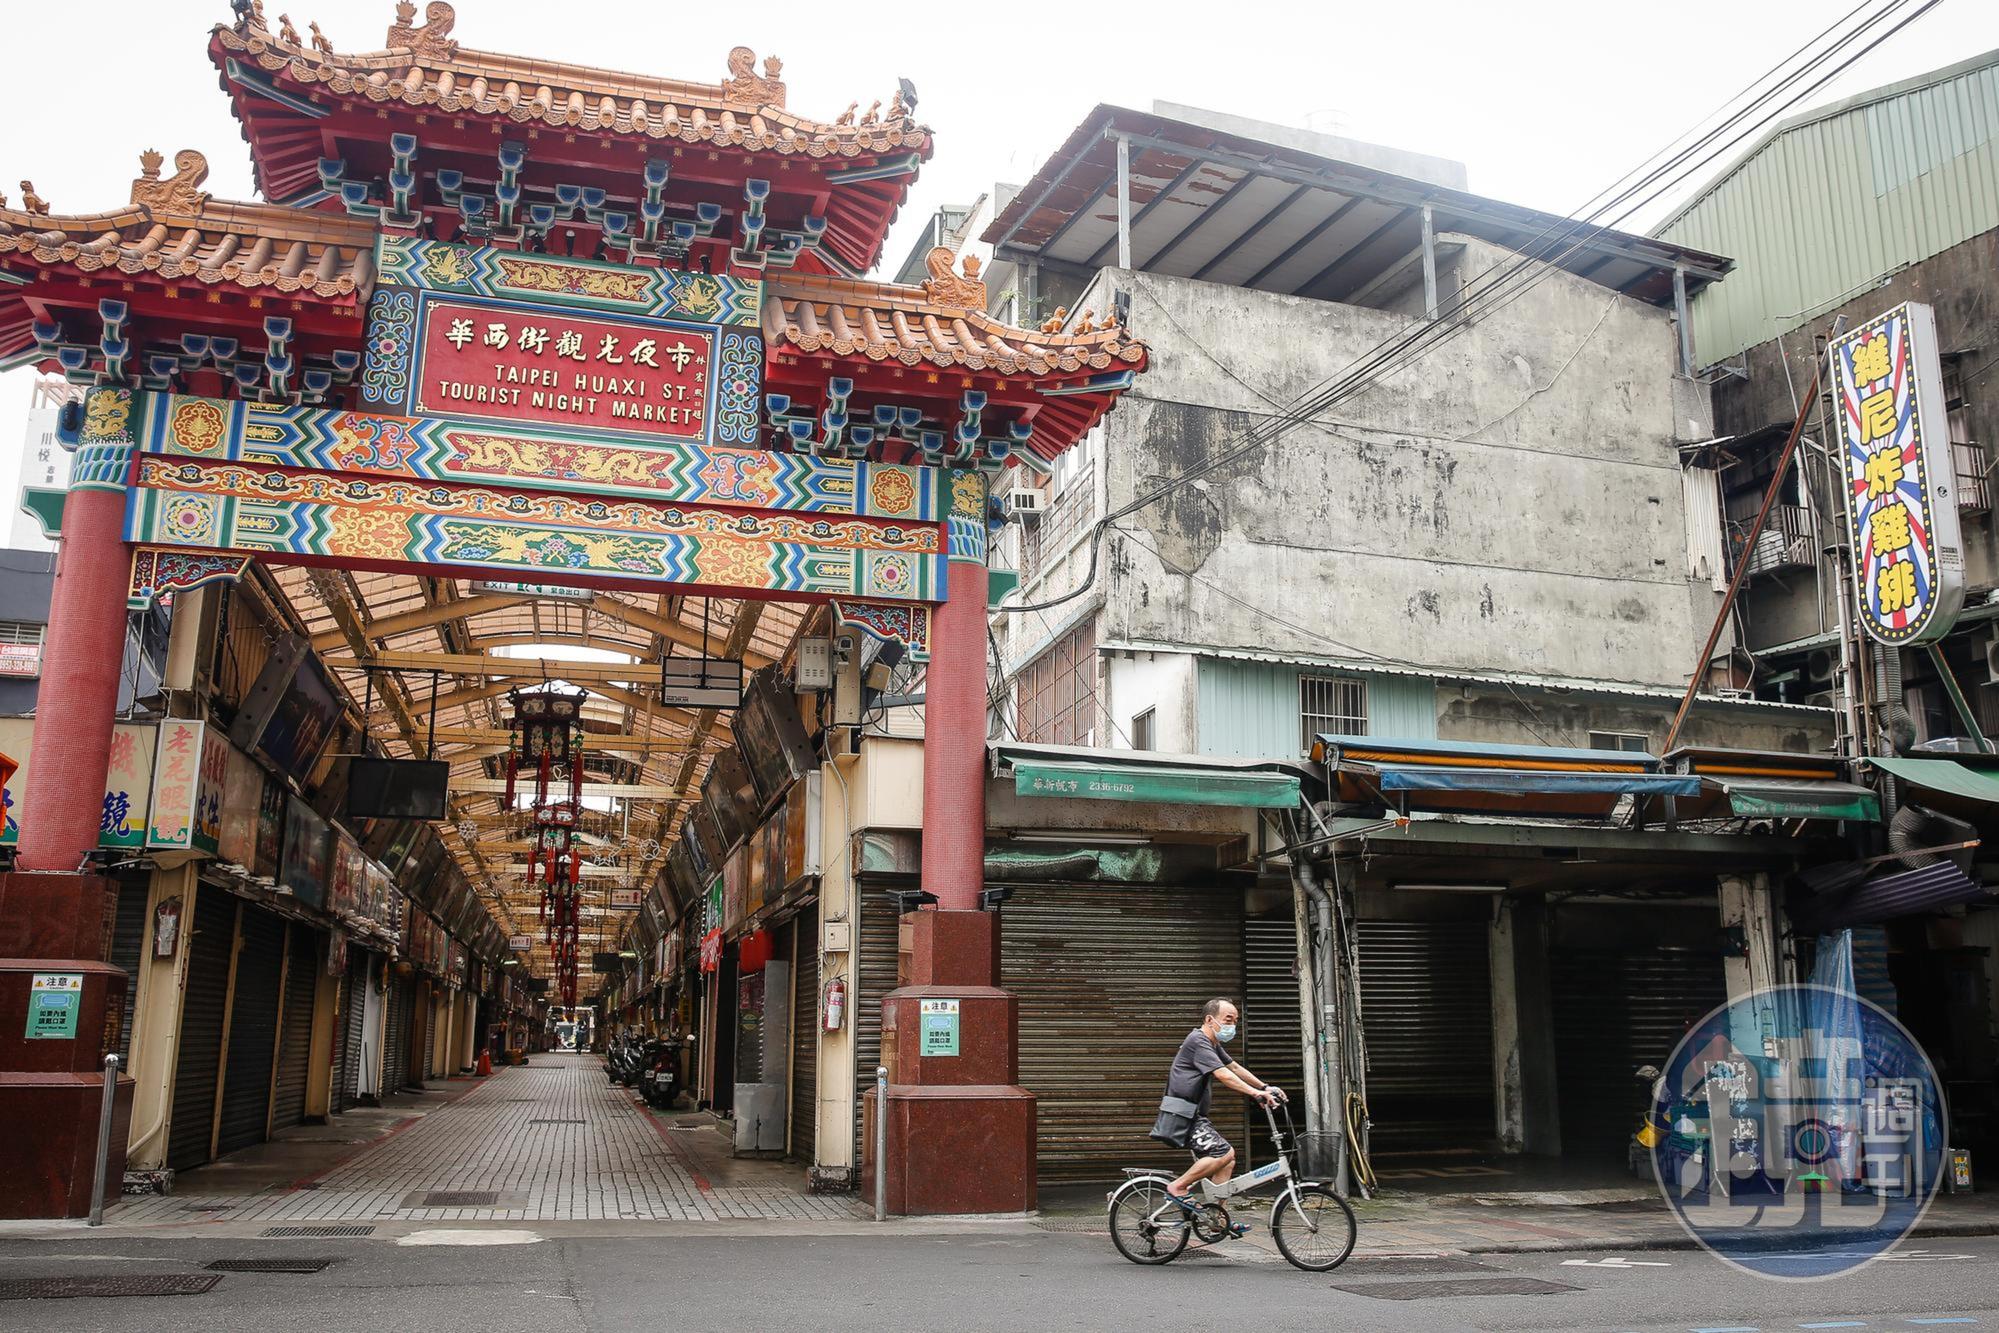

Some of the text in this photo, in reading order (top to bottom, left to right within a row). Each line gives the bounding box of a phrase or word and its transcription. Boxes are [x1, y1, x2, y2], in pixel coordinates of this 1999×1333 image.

[445, 318, 695, 374] 華西街觀光夜市
[439, 380, 692, 425] TOURIST NIGHT MARKET
[495, 364, 691, 402] TAIPEI HUAXI ST.
[1851, 331, 1918, 616] 維尼炸雞排
[483, 581, 509, 590] EXIT
[156, 725, 193, 841] 老花眼鏡
[101, 790, 131, 836] 鏡
[46, 976, 67, 986] 注意
[931, 1002, 948, 1010] 注意
